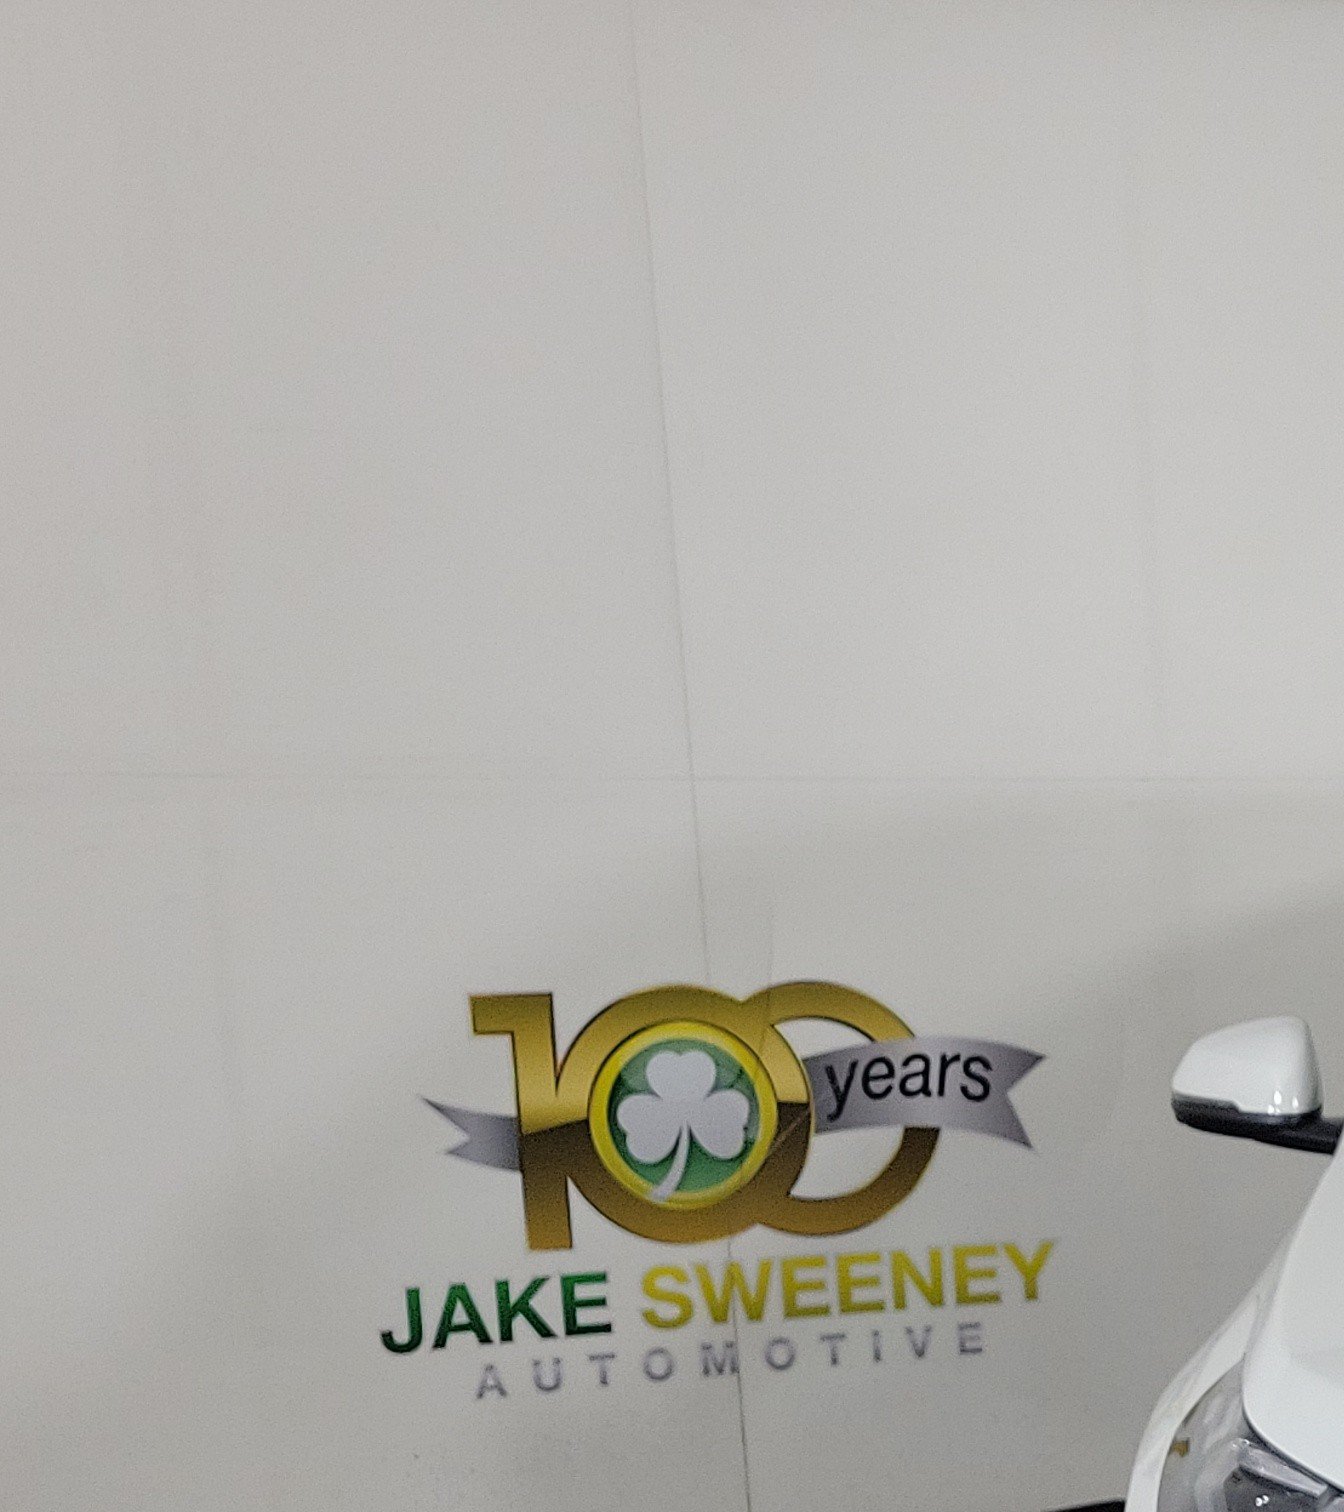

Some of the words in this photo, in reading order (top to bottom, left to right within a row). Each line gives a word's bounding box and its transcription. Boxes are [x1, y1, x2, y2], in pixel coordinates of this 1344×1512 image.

[469, 980, 941, 1250] 100
[824, 1053, 993, 1122] years
[380, 1271, 612, 1355] JAKE
[640, 1240, 1054, 1330] SWEENEY
[475, 1321, 985, 1399] AUTOMOTIVE
